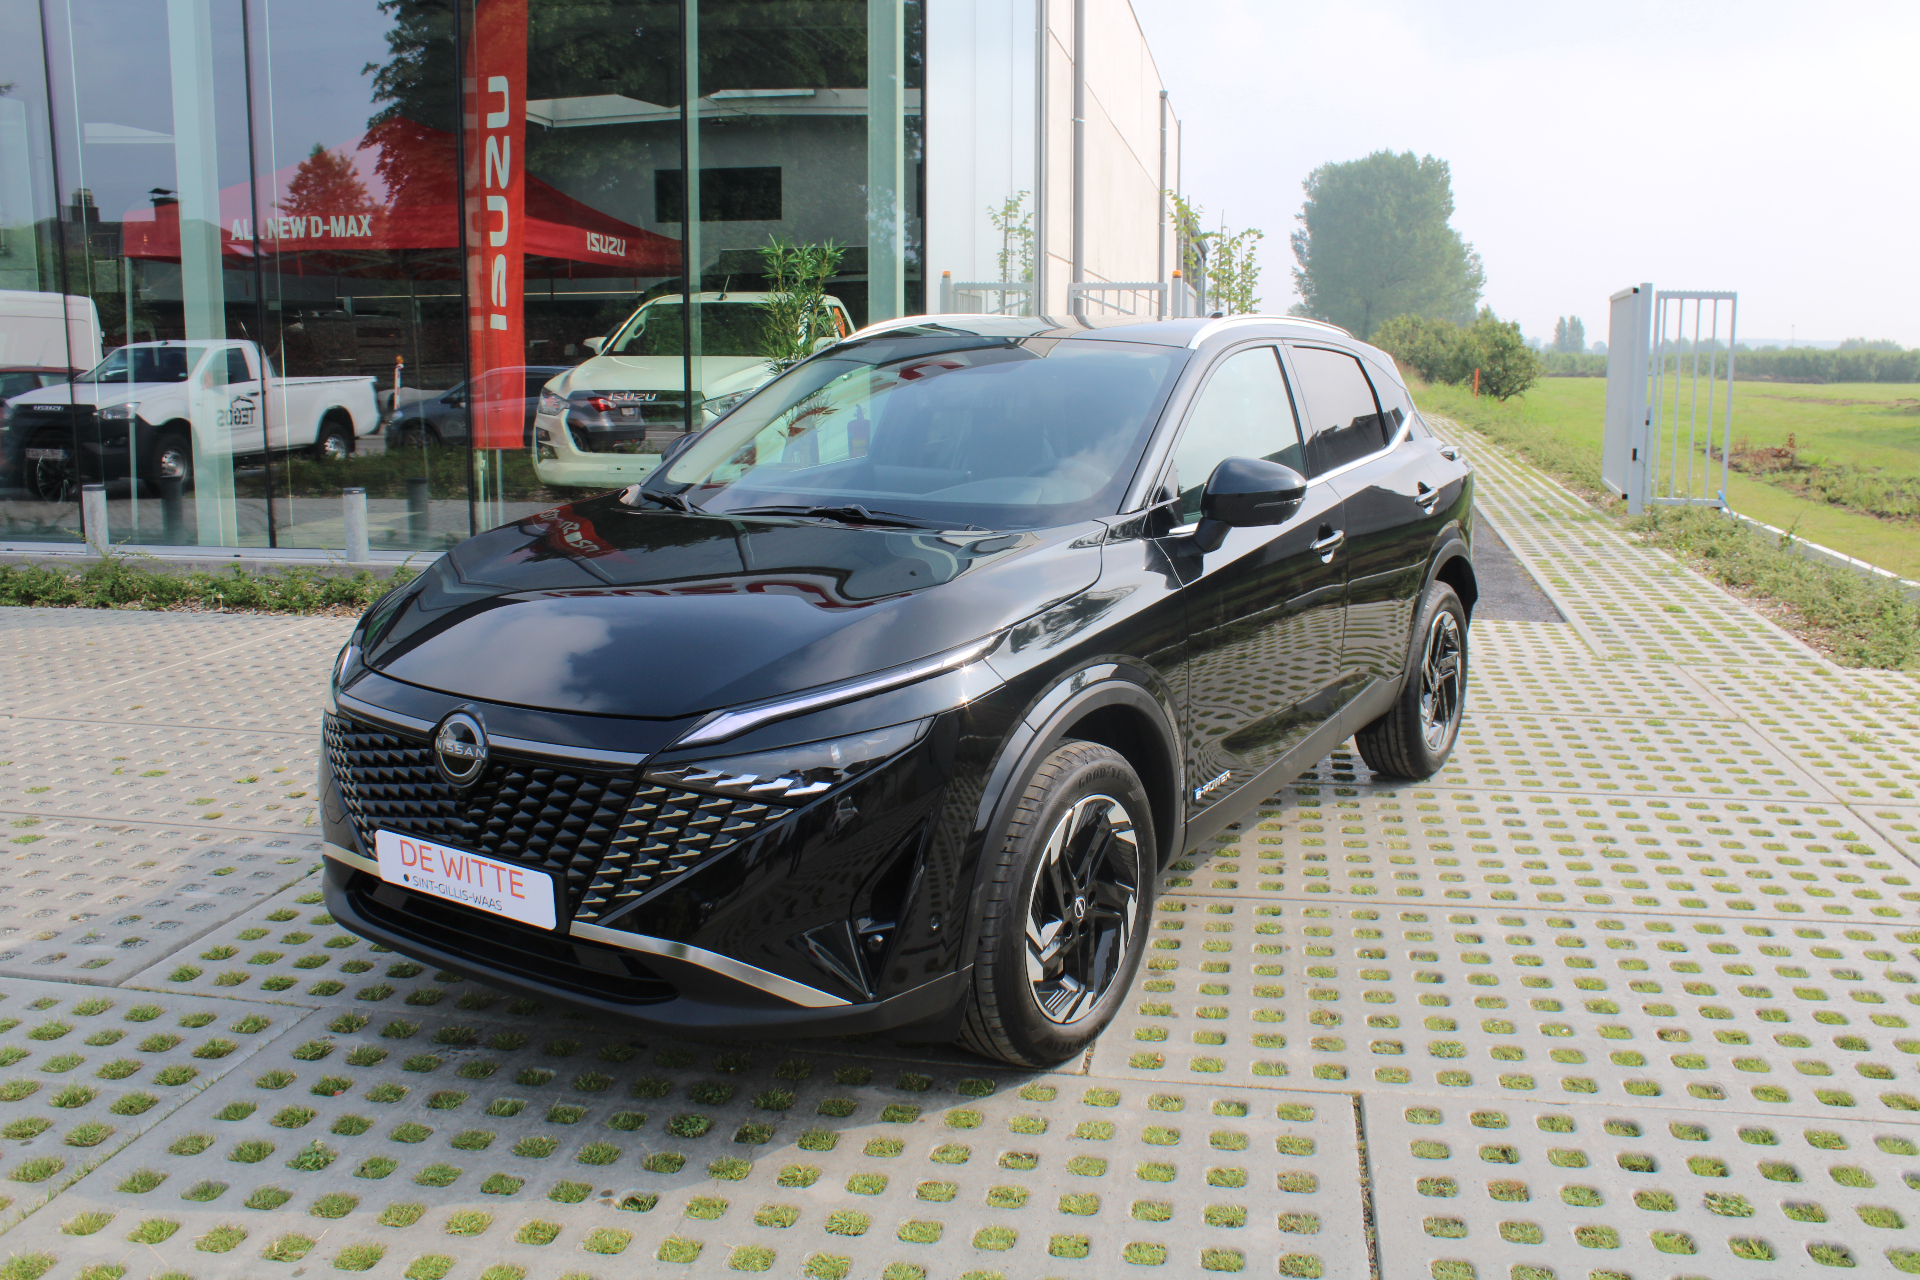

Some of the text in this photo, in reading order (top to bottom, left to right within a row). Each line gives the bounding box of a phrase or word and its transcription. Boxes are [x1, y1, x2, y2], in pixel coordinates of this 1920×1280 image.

[485, 75, 511, 331] ISUZU
[231, 214, 373, 241] AL NEW D-MAX
[586, 231, 626, 257] ISUZU
[608, 392, 657, 402] ISUZU
[435, 738, 487, 758] NISSAN
[399, 839, 526, 900] DE WITTE
[412, 875, 503, 911] SINT-GILLIS-WAAS
